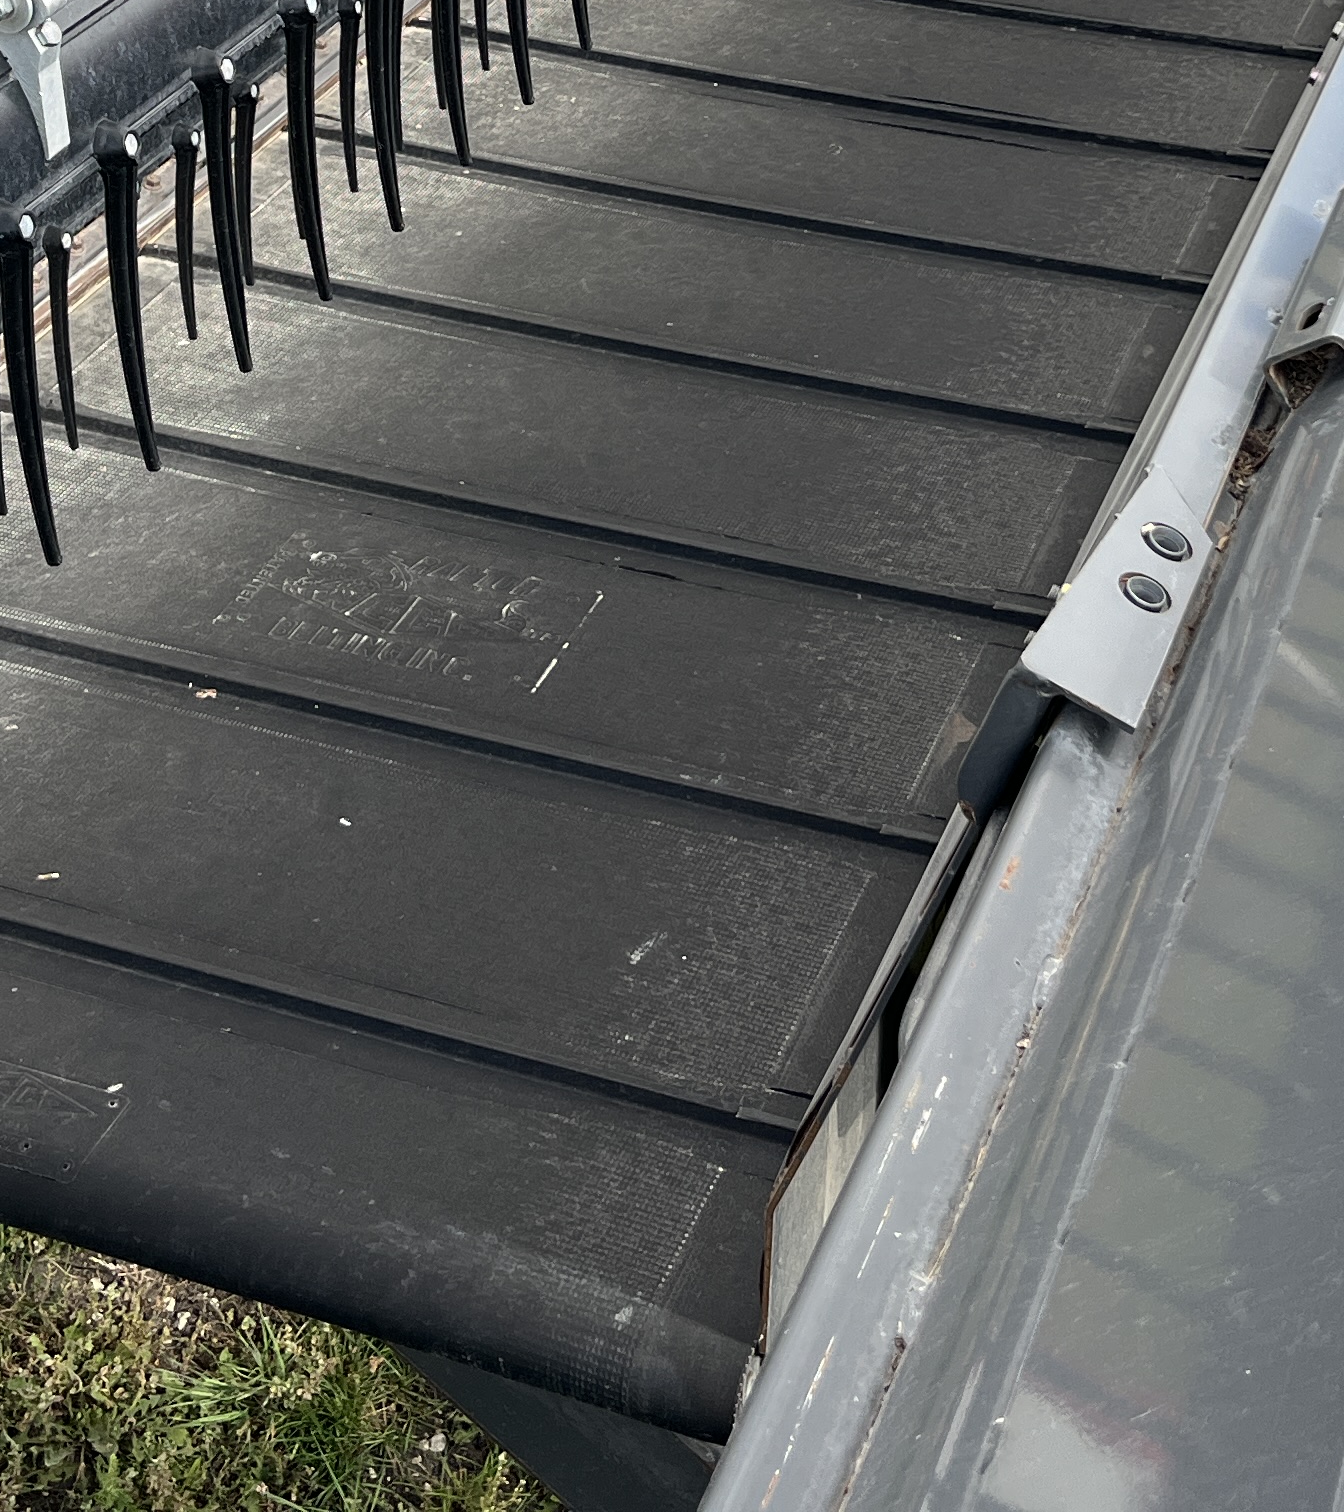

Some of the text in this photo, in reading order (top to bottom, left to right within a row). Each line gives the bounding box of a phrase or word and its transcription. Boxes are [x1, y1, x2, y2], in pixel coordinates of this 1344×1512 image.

[409, 554, 544, 597] RAPTOR
[267, 616, 473, 682] BELTING INC.
